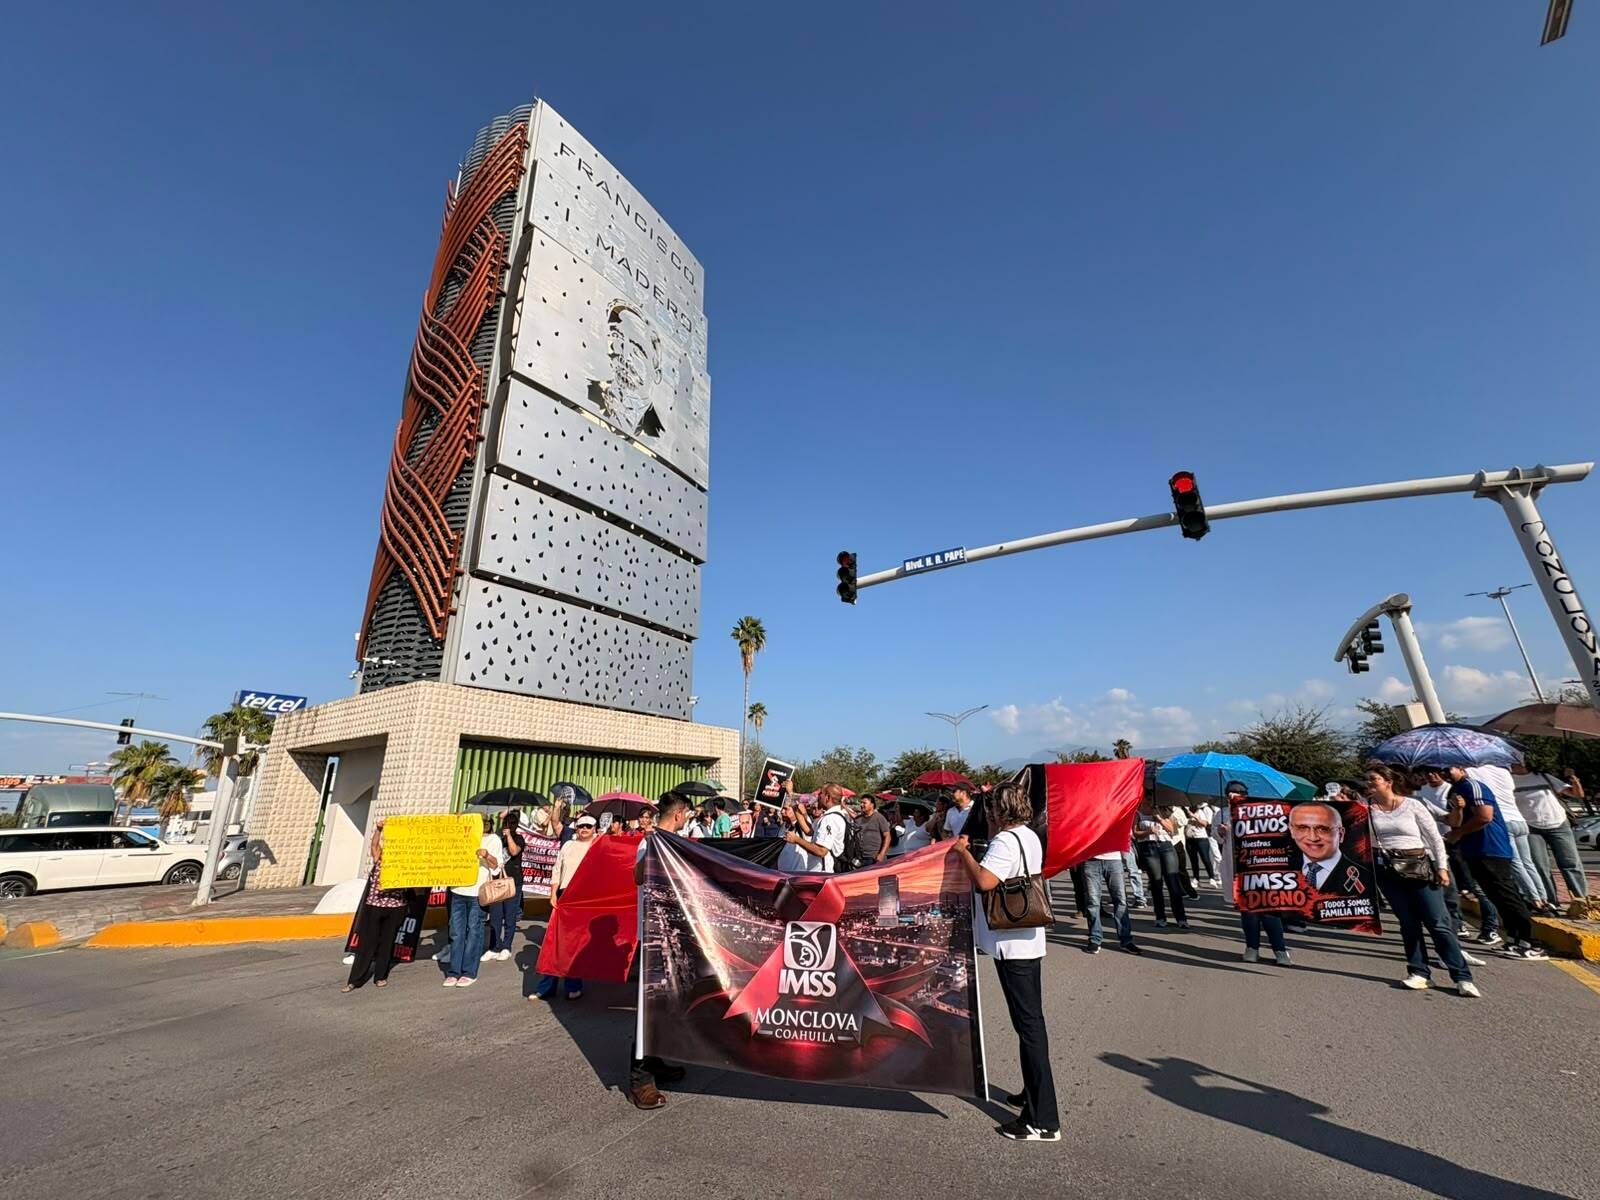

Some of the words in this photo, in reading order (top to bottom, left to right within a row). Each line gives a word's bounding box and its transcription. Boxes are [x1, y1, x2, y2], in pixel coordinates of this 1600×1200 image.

[560, 142, 695, 286] FRANCISCO
[596, 233, 692, 333] MADERO
[944, 550, 964, 561] PAPE
[241, 693, 304, 713] telcel
[1238, 804, 1284, 819] FUERA
[1235, 816, 1288, 838] OLIVOS
[1241, 840, 1271, 849] Nuestras
[1240, 849, 1248, 864] 2
[1250, 847, 1286, 856] neuronas
[1253, 855, 1288, 864] funcionan
[1243, 872, 1298, 891] IMSS
[1245, 890, 1306, 908] DIGNO
[1347, 898, 1370, 907] SOMOS
[1320, 907, 1353, 918] FAMILIA
[1354, 906, 1374, 915] IMSS
[779, 969, 837, 997] IMSS
[754, 1007, 859, 1031] MONCLOVA
[774, 1028, 836, 1043] COAHUILA
